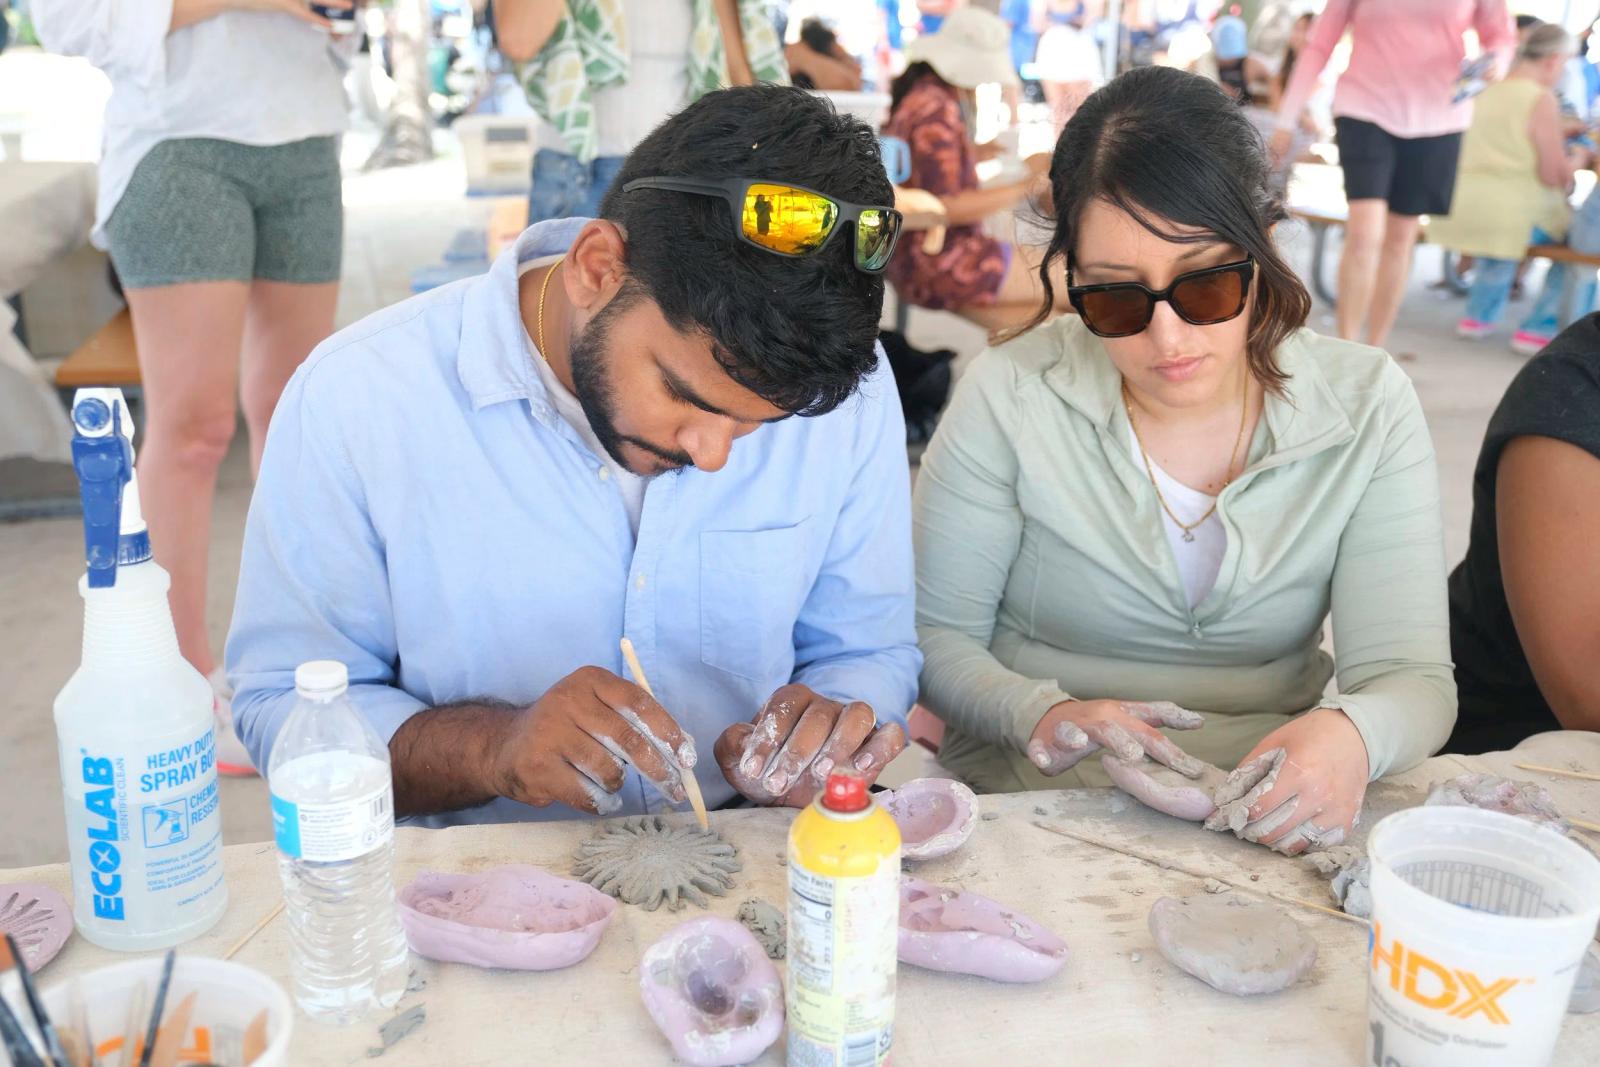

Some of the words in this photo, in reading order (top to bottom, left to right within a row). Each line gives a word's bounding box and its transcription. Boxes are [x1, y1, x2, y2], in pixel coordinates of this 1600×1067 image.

[115, 757, 125, 790] CLEAN
[140, 760, 197, 793] SPRAY
[147, 744, 192, 769] HEAVY
[117, 791, 130, 842] SCIENTIFIC
[82, 756, 126, 921] ECOLAB
[1372, 920, 1520, 1025] HDX
